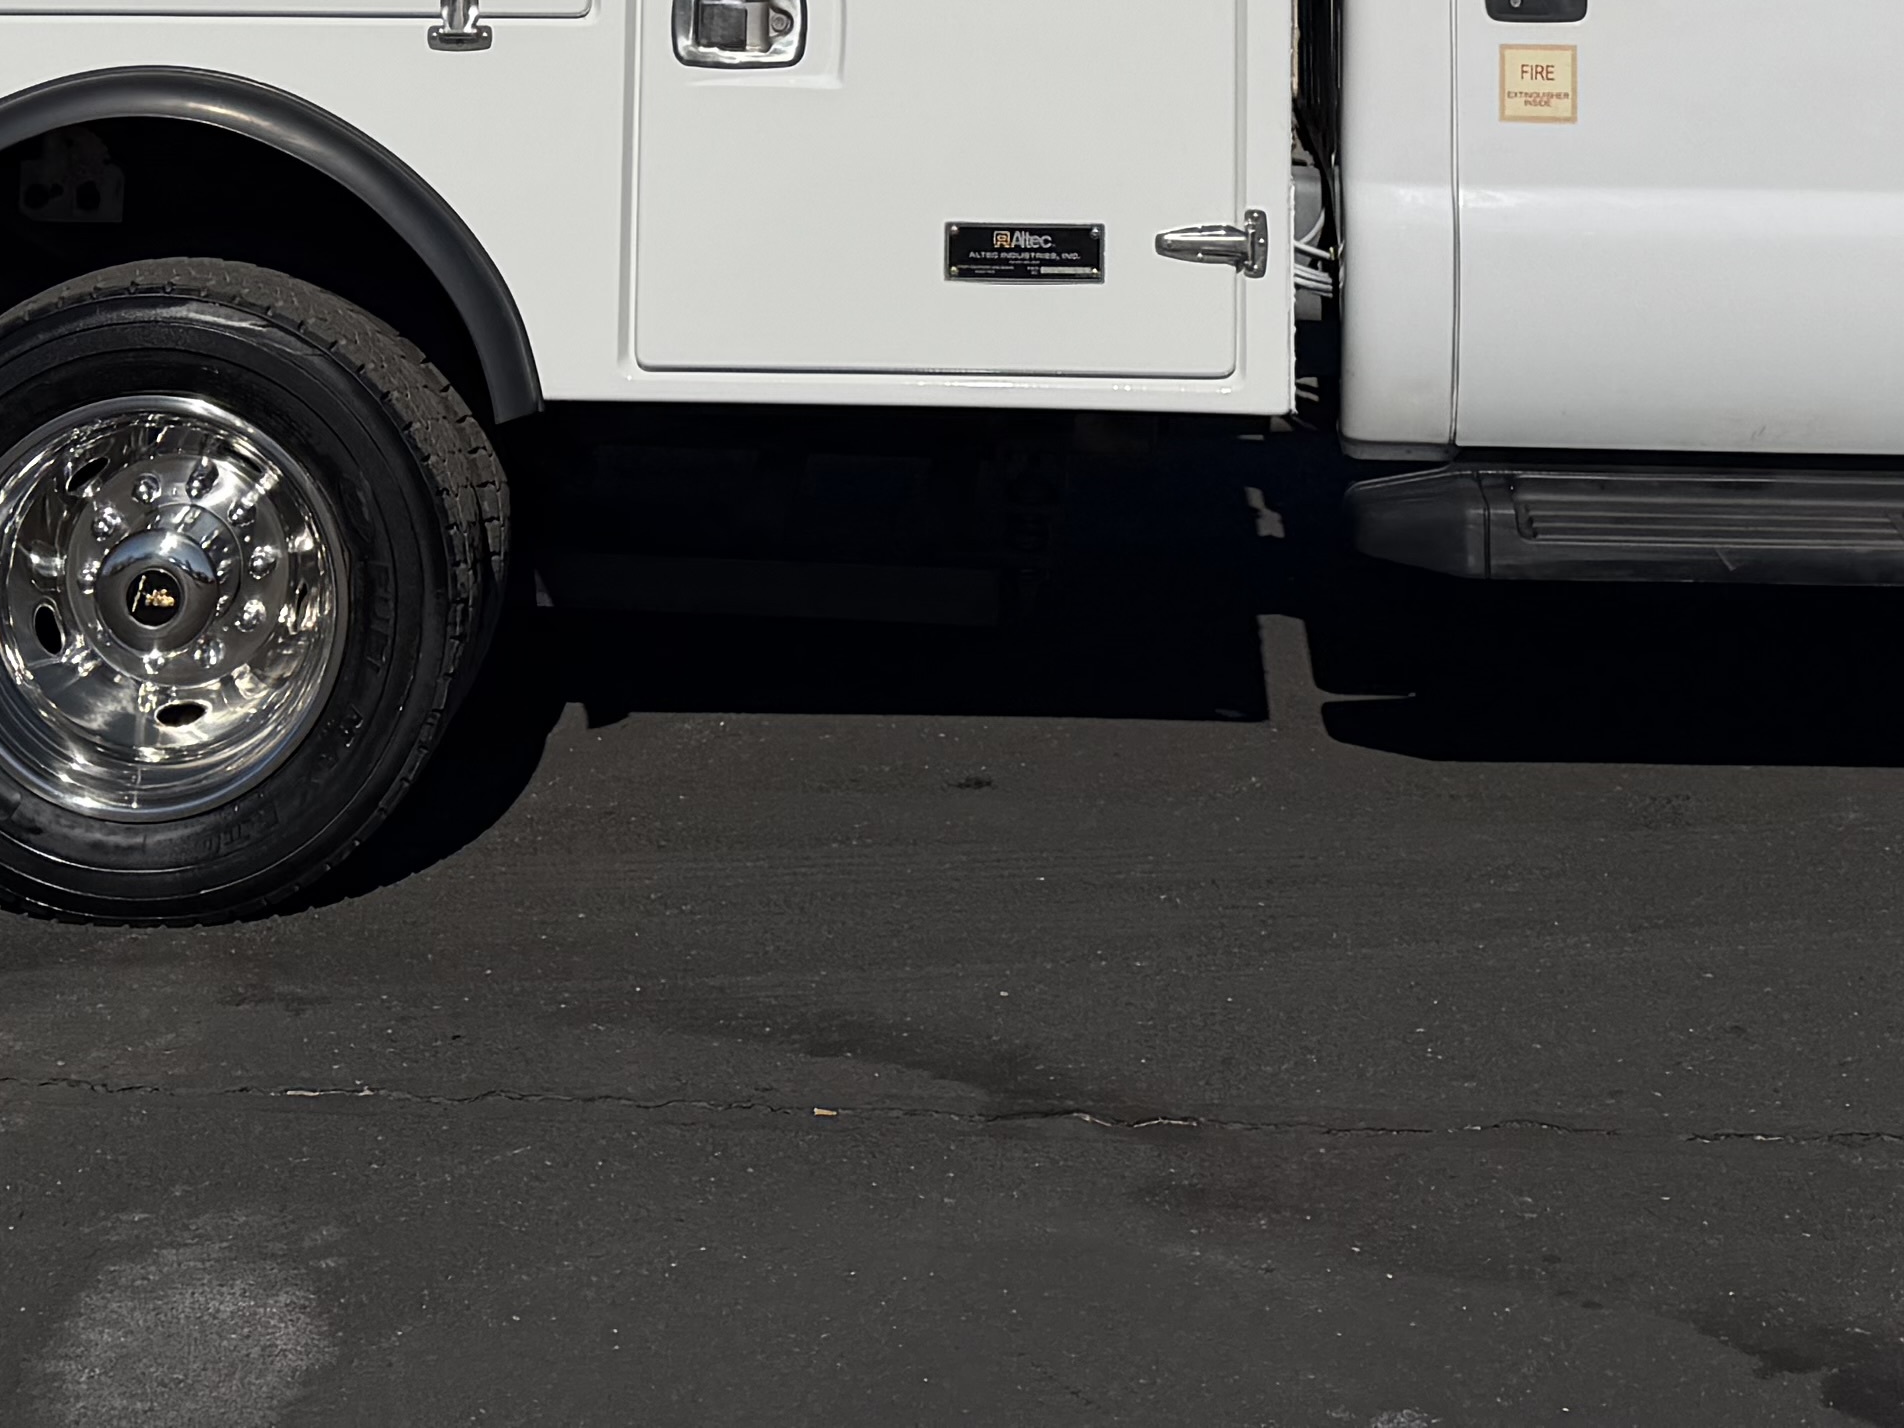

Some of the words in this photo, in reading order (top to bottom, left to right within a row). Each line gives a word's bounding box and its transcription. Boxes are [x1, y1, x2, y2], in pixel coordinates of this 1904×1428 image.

[1520, 63, 1556, 81] FIRE
[1011, 230, 1053, 249] Altec
[968, 251, 999, 260] ALTEC
